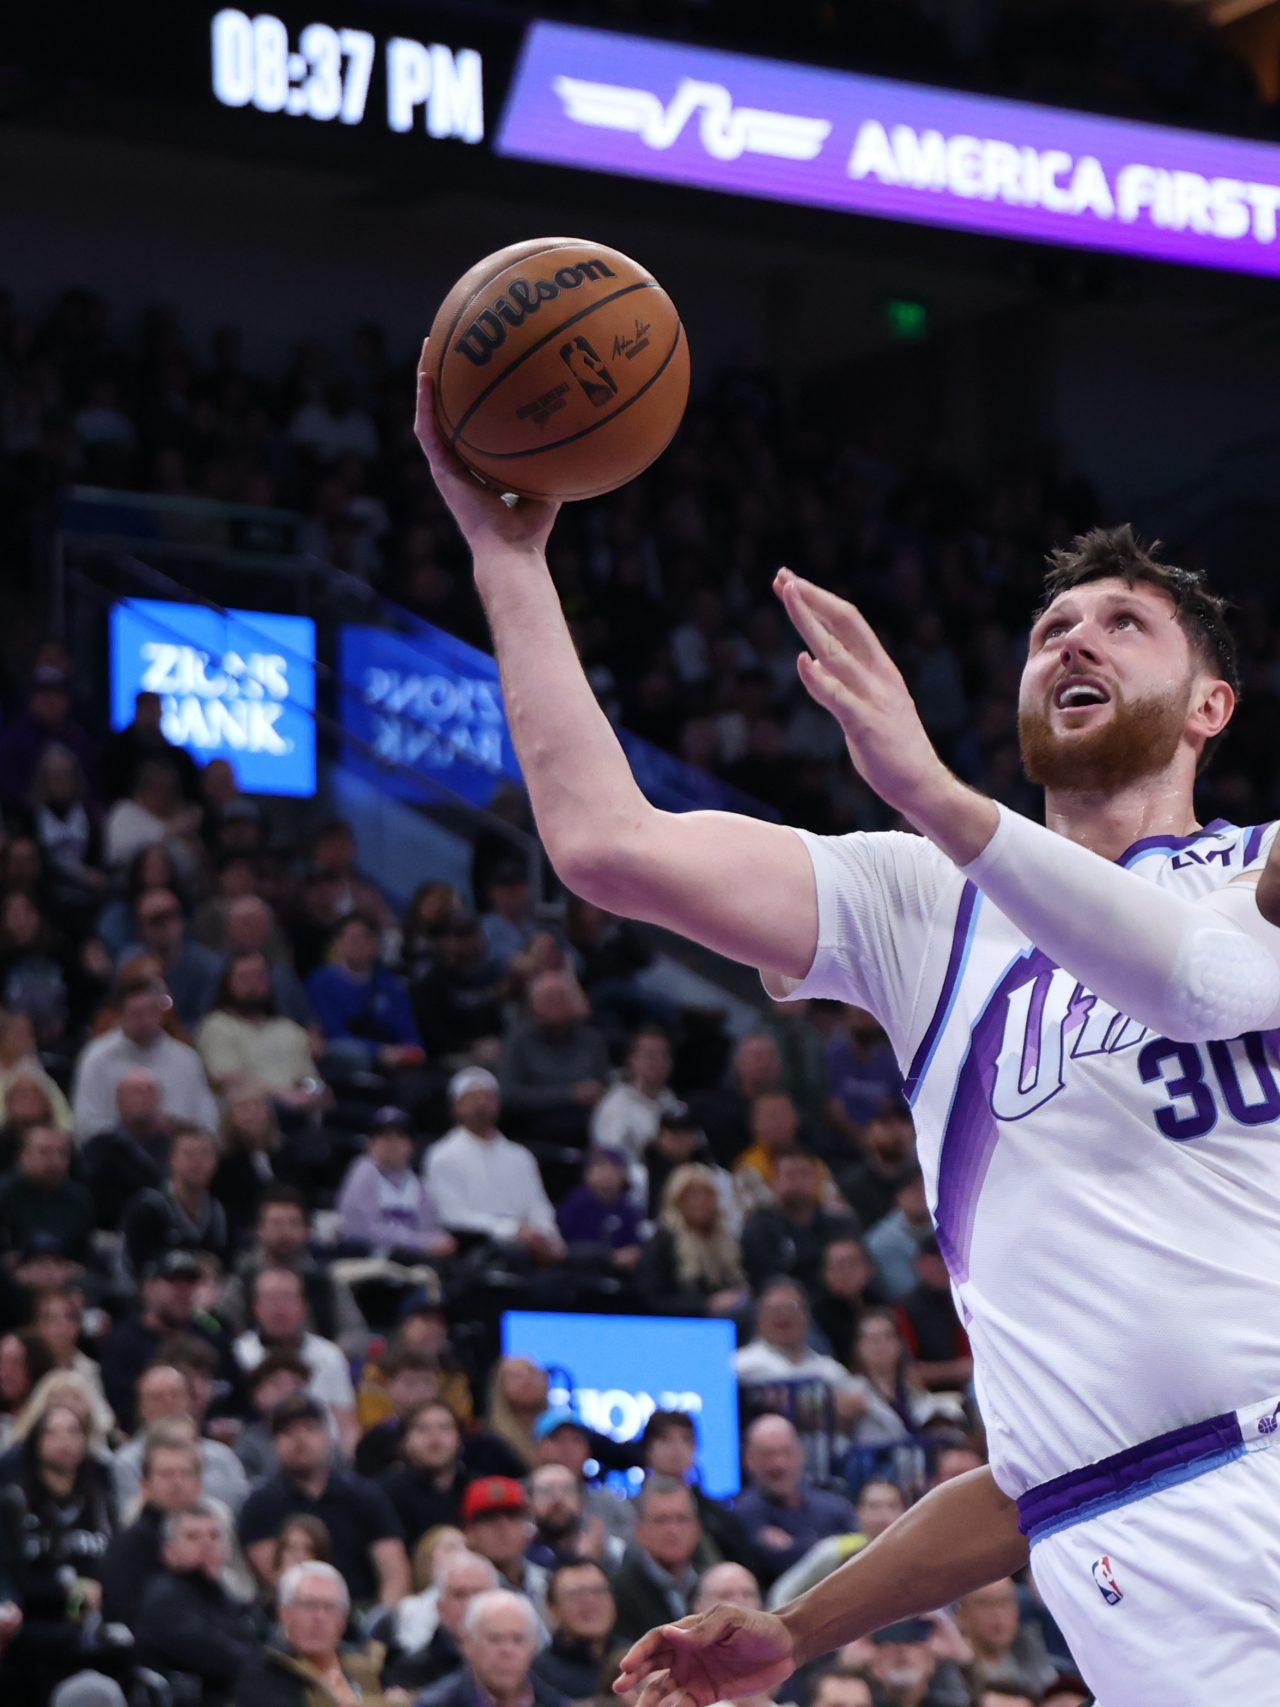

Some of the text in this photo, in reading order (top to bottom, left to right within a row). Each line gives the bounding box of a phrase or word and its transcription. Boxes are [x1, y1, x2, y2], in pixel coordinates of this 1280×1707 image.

[211, 7, 485, 143] 08:37 PM
[847, 119, 1116, 220] AMERICA
[455, 258, 616, 366] Wilson
